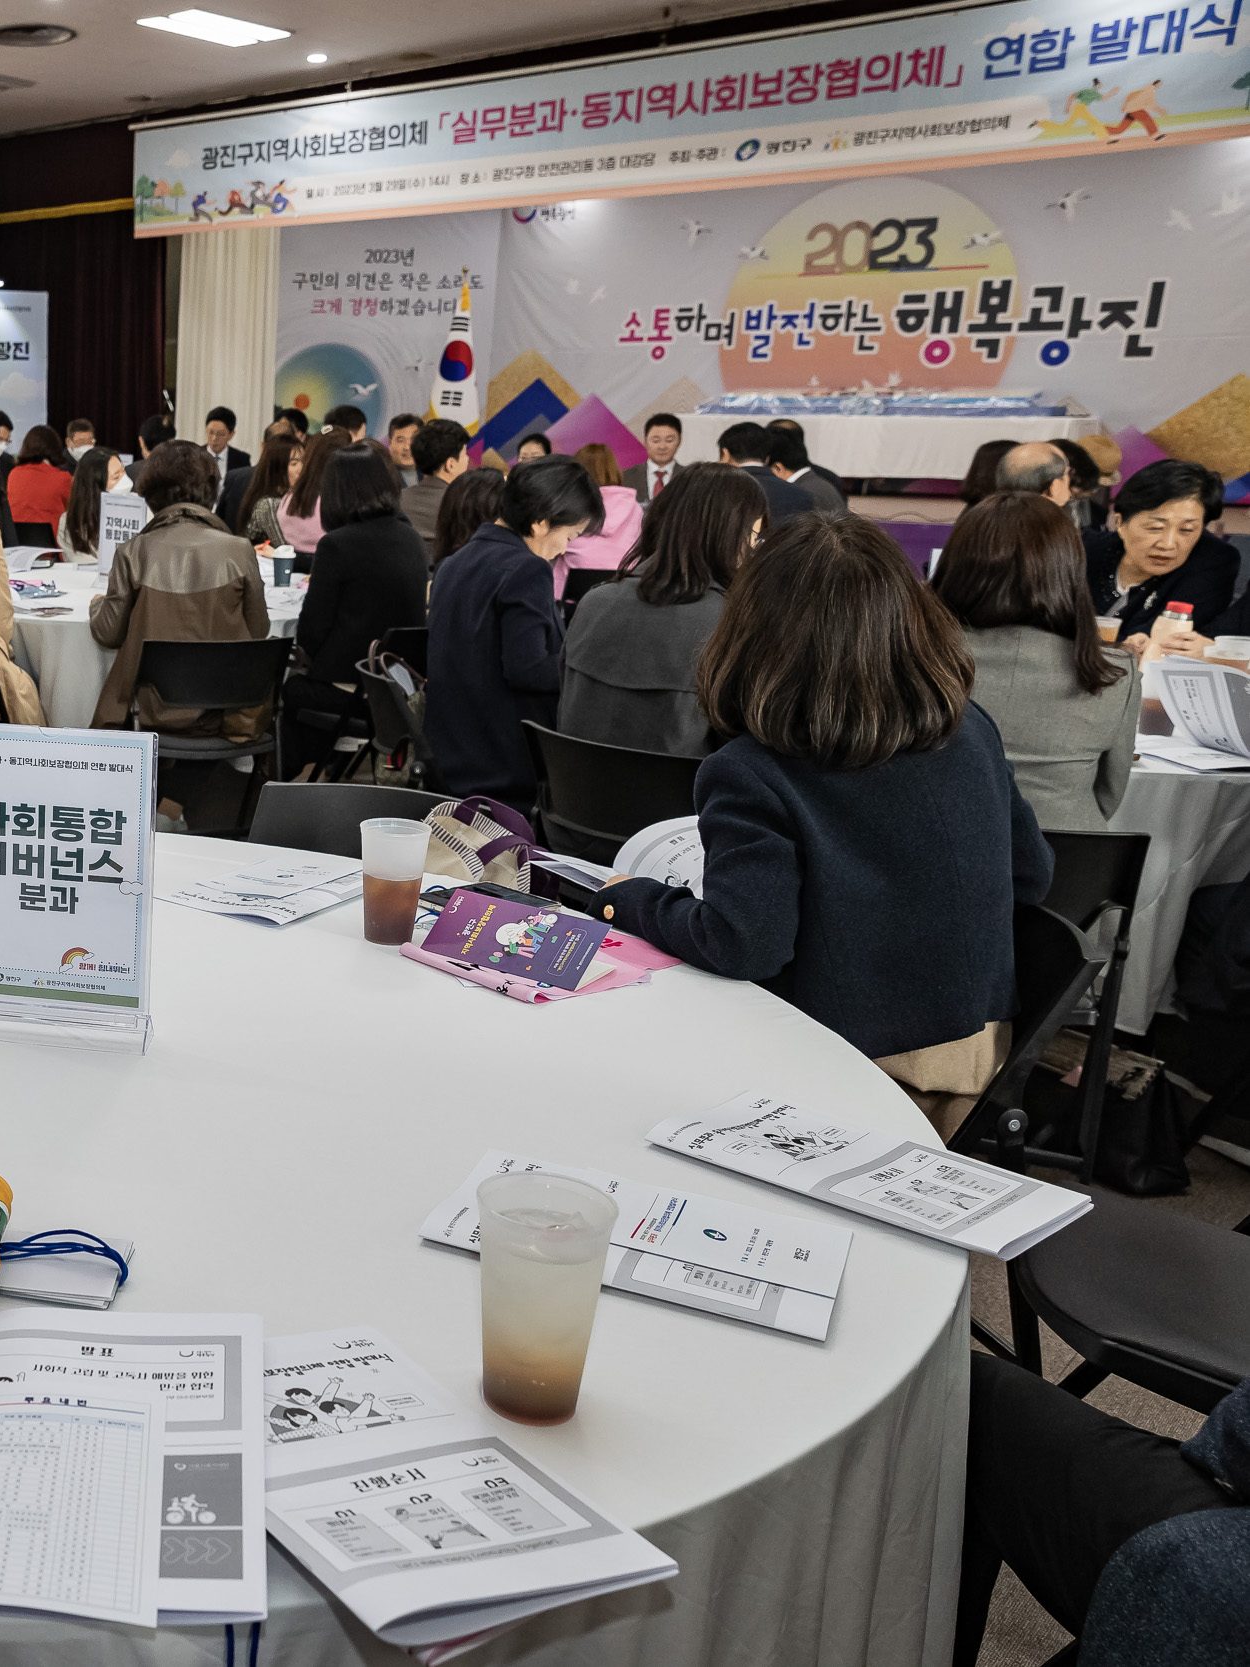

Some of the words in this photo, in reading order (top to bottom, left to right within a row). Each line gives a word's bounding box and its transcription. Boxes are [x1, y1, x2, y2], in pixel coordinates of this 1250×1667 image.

[201, 118, 428, 171] 광진구지역사회보장협의체
[983, 26, 1075, 81] 연합
[1086, 1, 1242, 67] 발대식
[765, 137, 813, 156] 광진구
[853, 115, 1012, 147] 광진구지역사회보장협의체
[364, 247, 416, 267] 2023년
[803, 217, 938, 275] 2023
[292, 272, 340, 291] 구민의
[346, 272, 394, 291] 의견은
[399, 272, 431, 290] 작은
[436, 273, 485, 290] 소리도
[310, 297, 343, 316] 크게
[618, 301, 736, 361] 소통하며
[743, 298, 883, 359] 발전하는
[895, 279, 1167, 367] 행복광진
[105, 516, 140, 531] 지역사회
[9, 756, 89, 771] 동지역사회보장협의체
[90, 762, 107, 772] 연합
[108, 763, 134, 774] 발대식
[18, 882, 79, 915] 분과
[460, 904, 497, 955] 지역사회보장협의체
[461, 918, 478, 936] 광진구
[78, 962, 97, 971] 함께!
[352, 1467, 427, 1493] 진행순서
